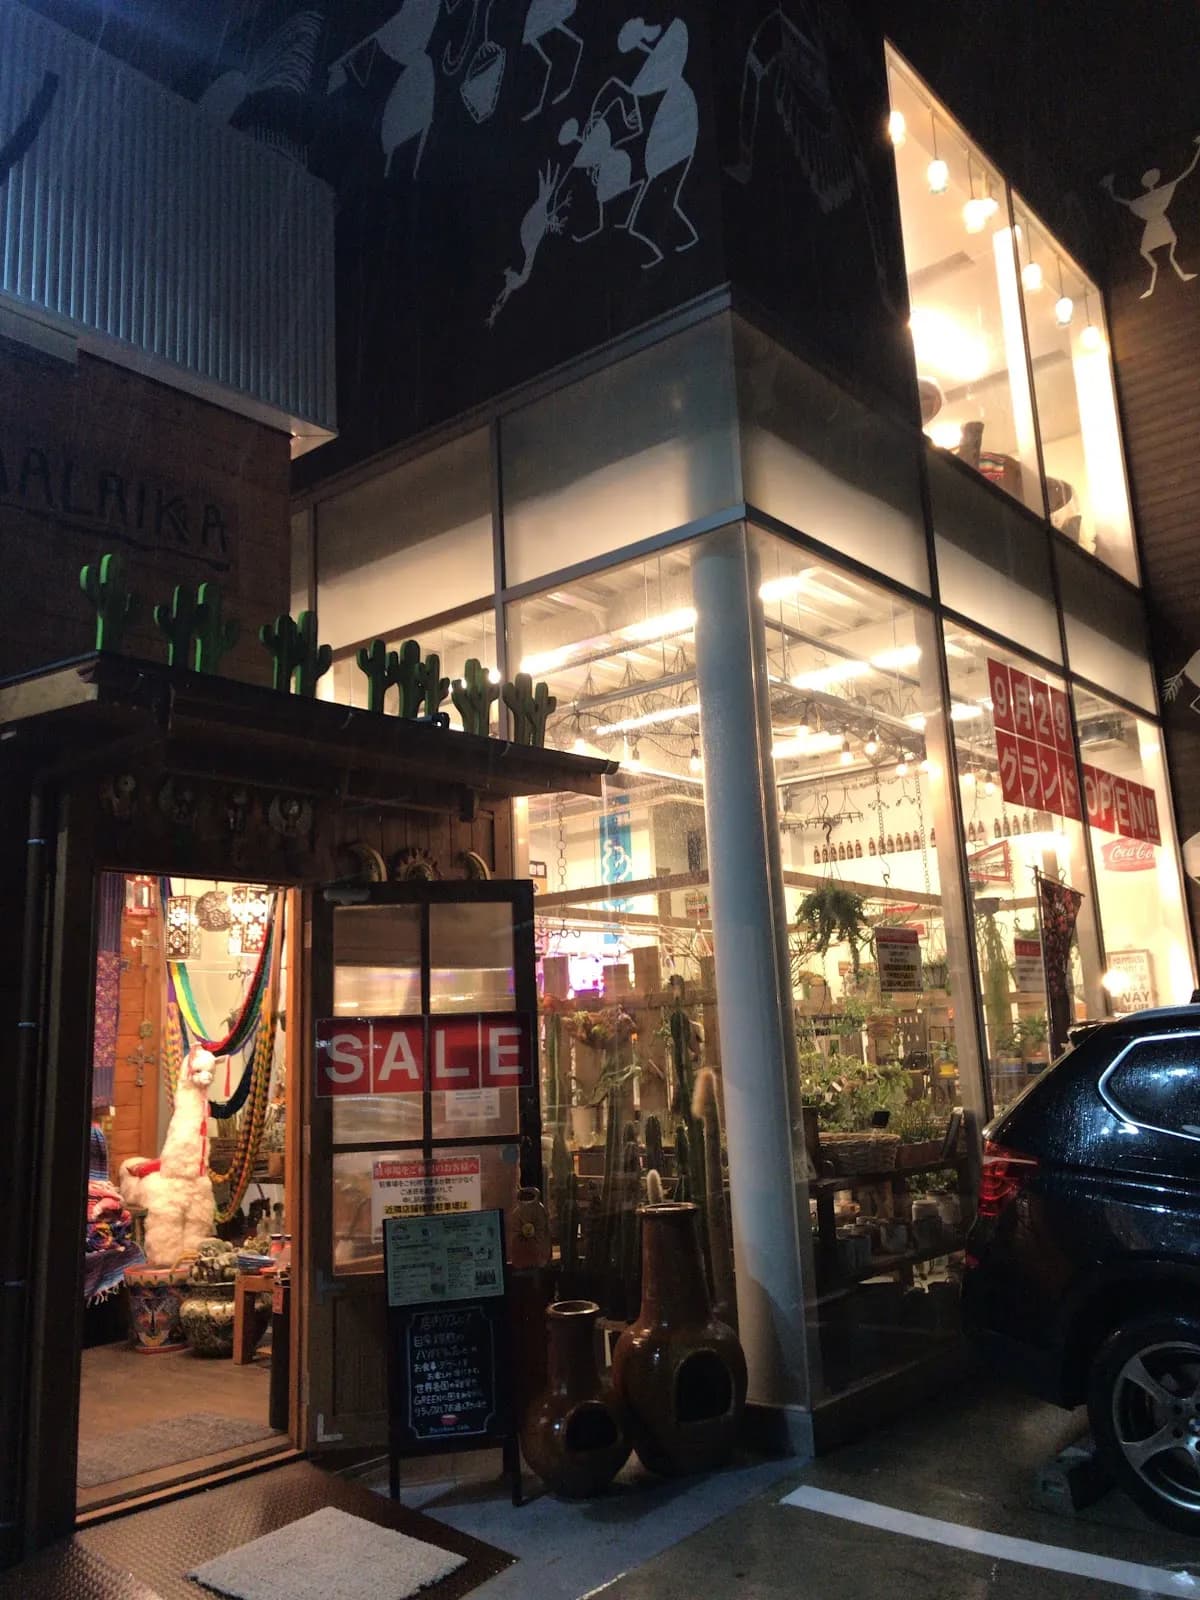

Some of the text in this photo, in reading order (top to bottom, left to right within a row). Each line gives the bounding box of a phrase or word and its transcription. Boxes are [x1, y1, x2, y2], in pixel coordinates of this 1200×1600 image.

[0, 446, 228, 552] ALAIKA
[993, 675, 1068, 741] 9月29
[324, 1027, 524, 1083] SALE
